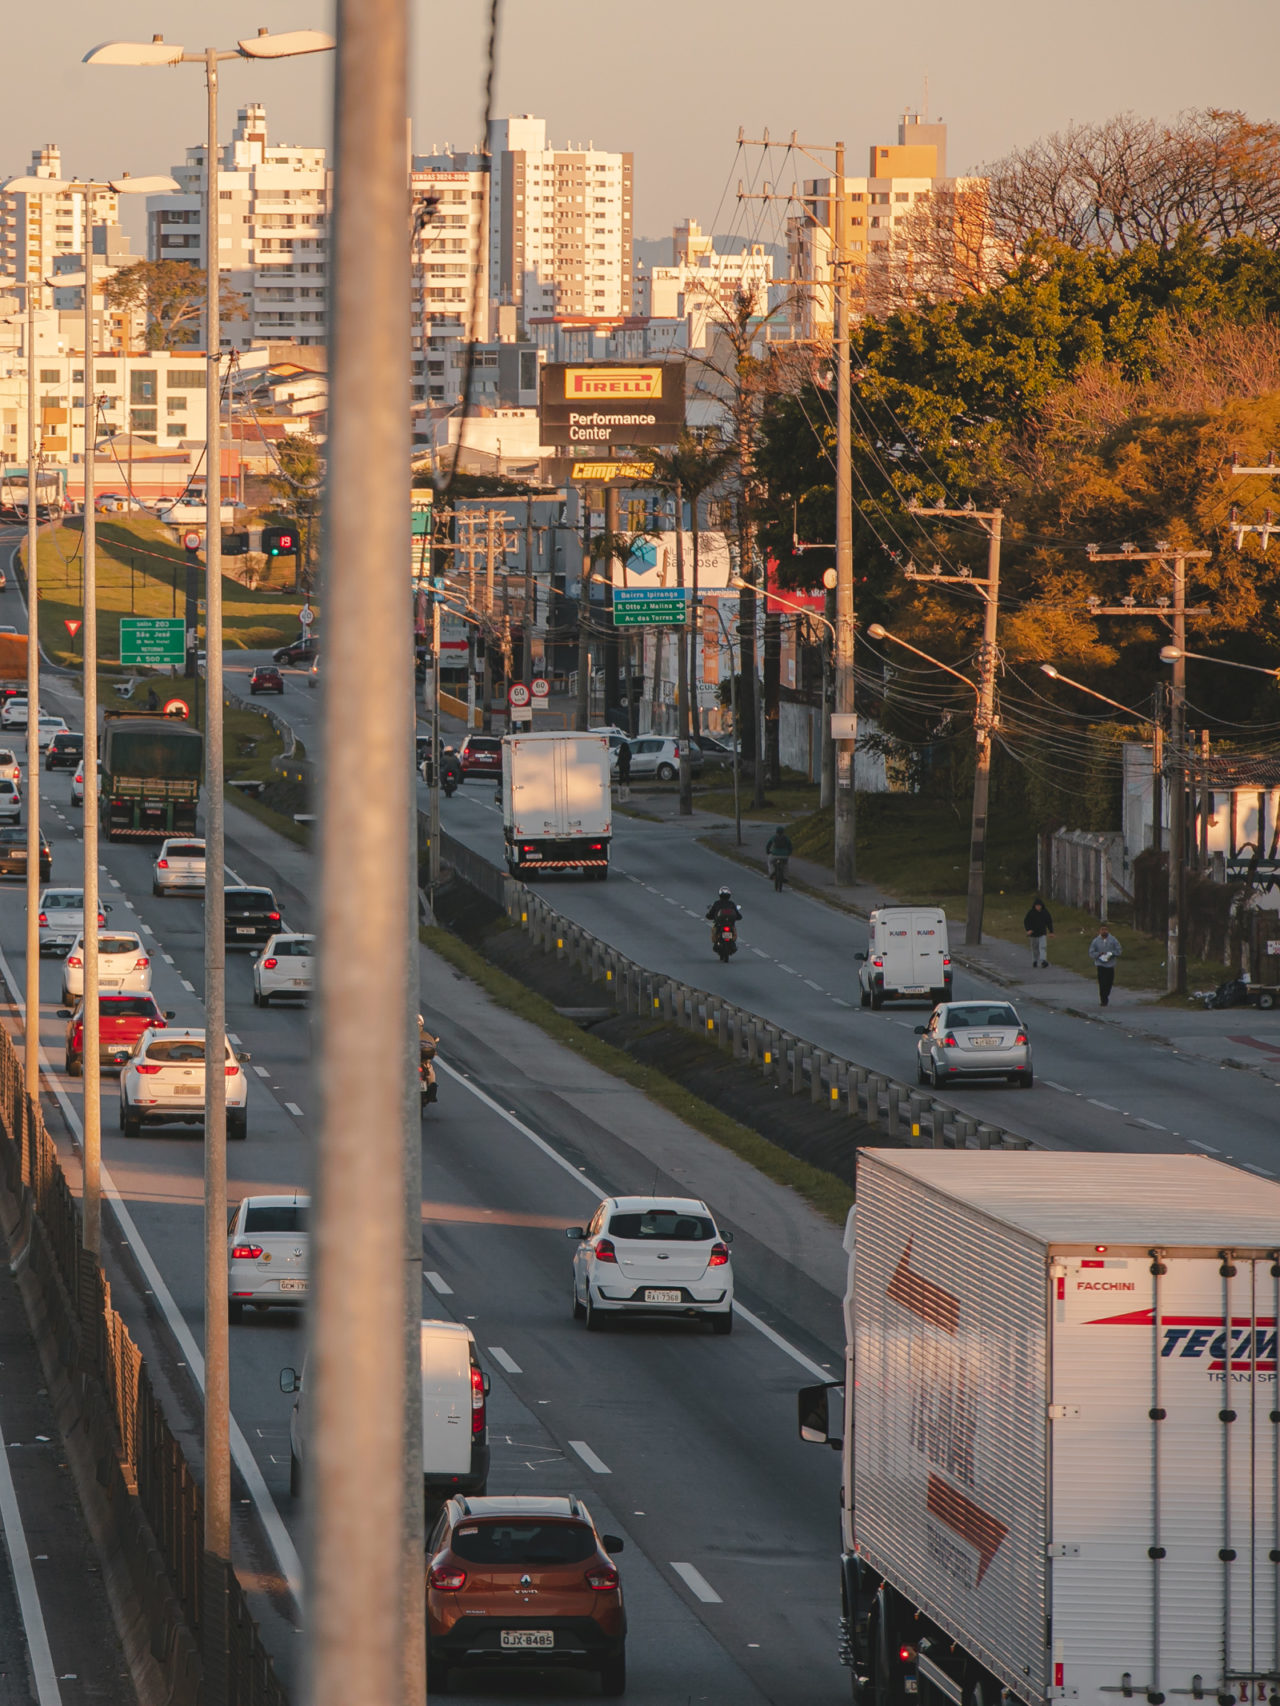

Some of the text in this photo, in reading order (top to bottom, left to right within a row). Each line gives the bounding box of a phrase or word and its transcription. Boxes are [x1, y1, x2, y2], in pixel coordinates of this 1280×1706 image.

[574, 374, 653, 392] PIRELLI
[569, 412, 656, 425] Performance
[569, 426, 612, 440] Center
[514, 688, 525, 696] 60
[1077, 1281, 1135, 1291] FACCHINI
